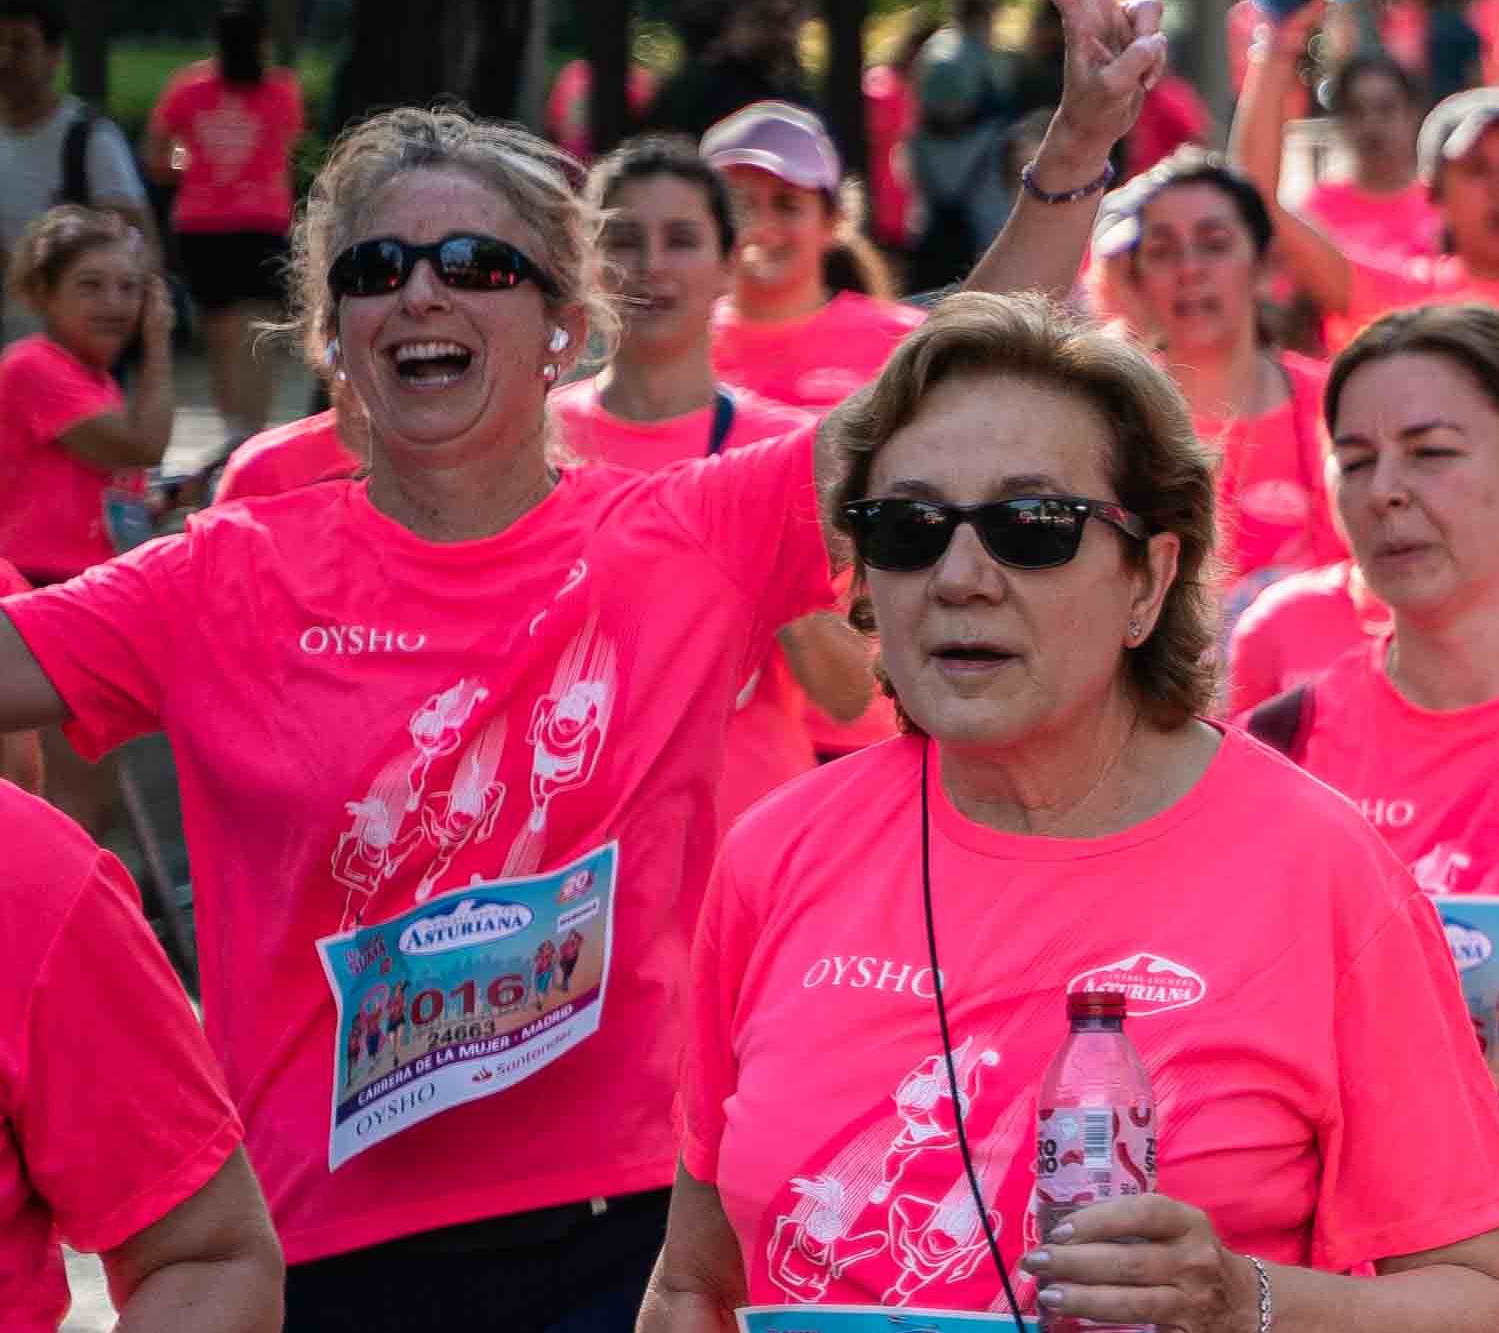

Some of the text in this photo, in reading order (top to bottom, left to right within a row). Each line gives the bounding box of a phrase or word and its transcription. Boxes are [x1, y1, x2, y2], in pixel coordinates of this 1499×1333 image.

[299, 625, 425, 654] OYSHO
[405, 914, 525, 949] ASTURIANA
[803, 956, 944, 999] OYSHO
[411, 974, 525, 1025] 016
[357, 1004, 573, 1104] CARRERA DE LA MUJER MADRID
[428, 1019, 497, 1048] 24663
[356, 1082, 436, 1136] OYSHO
